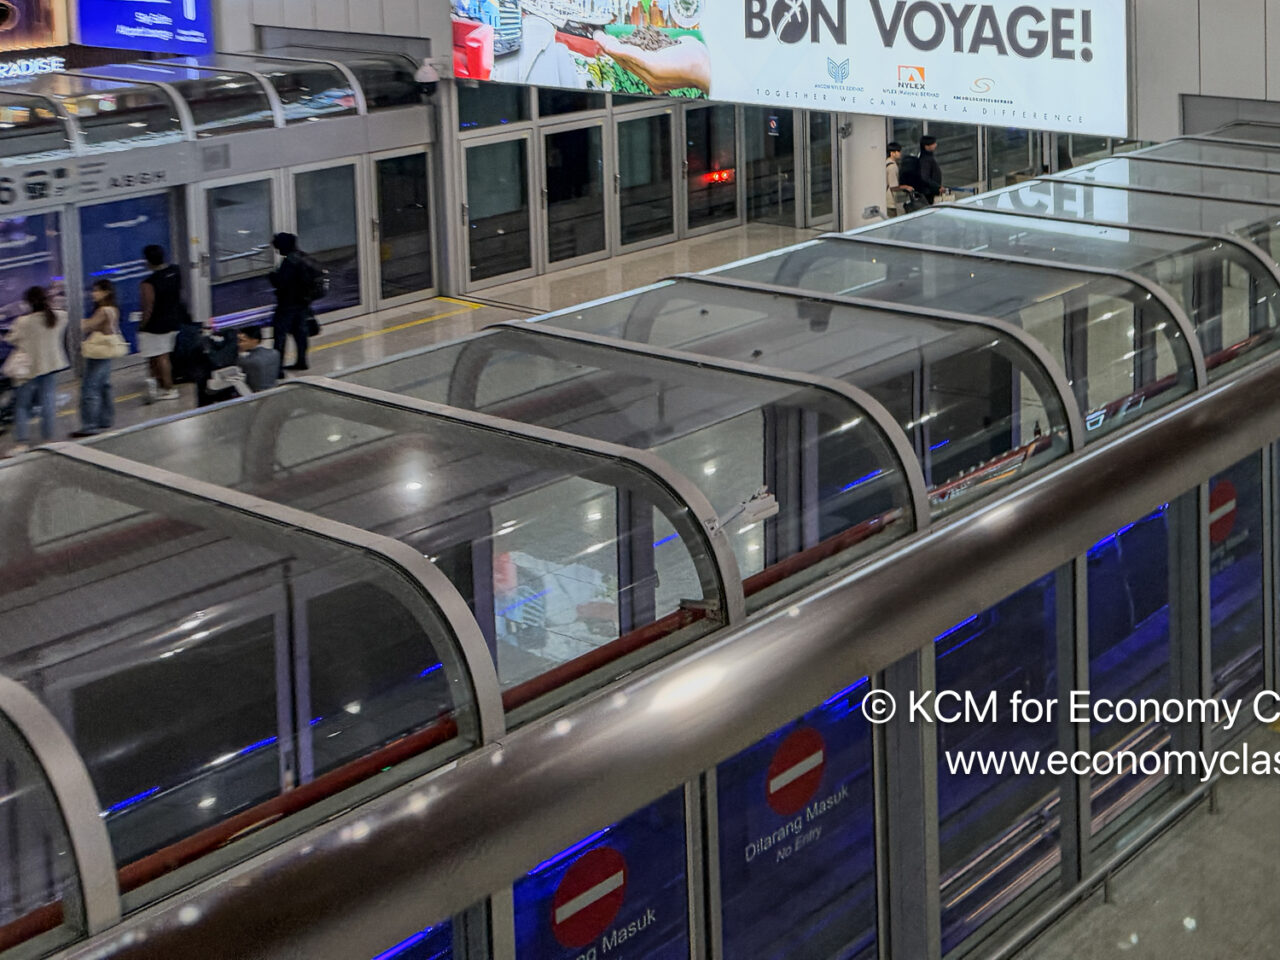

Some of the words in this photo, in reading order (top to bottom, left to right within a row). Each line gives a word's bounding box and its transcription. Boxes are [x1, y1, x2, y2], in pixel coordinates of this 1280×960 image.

[897, 82, 926, 90] NYLEX
[756, 89, 827, 101] TOGETHER
[840, 96, 856, 104] WE
[869, 97, 896, 107] CAN
[911, 101, 948, 112] MAKE
[982, 107, 1084, 124] DIFFERENCE
[744, 816, 802, 863] Dilarang
[806, 786, 849, 822] Masuk
[776, 844, 793, 864] No
[795, 826, 823, 854] Entry
[602, 908, 657, 953] Masuk
